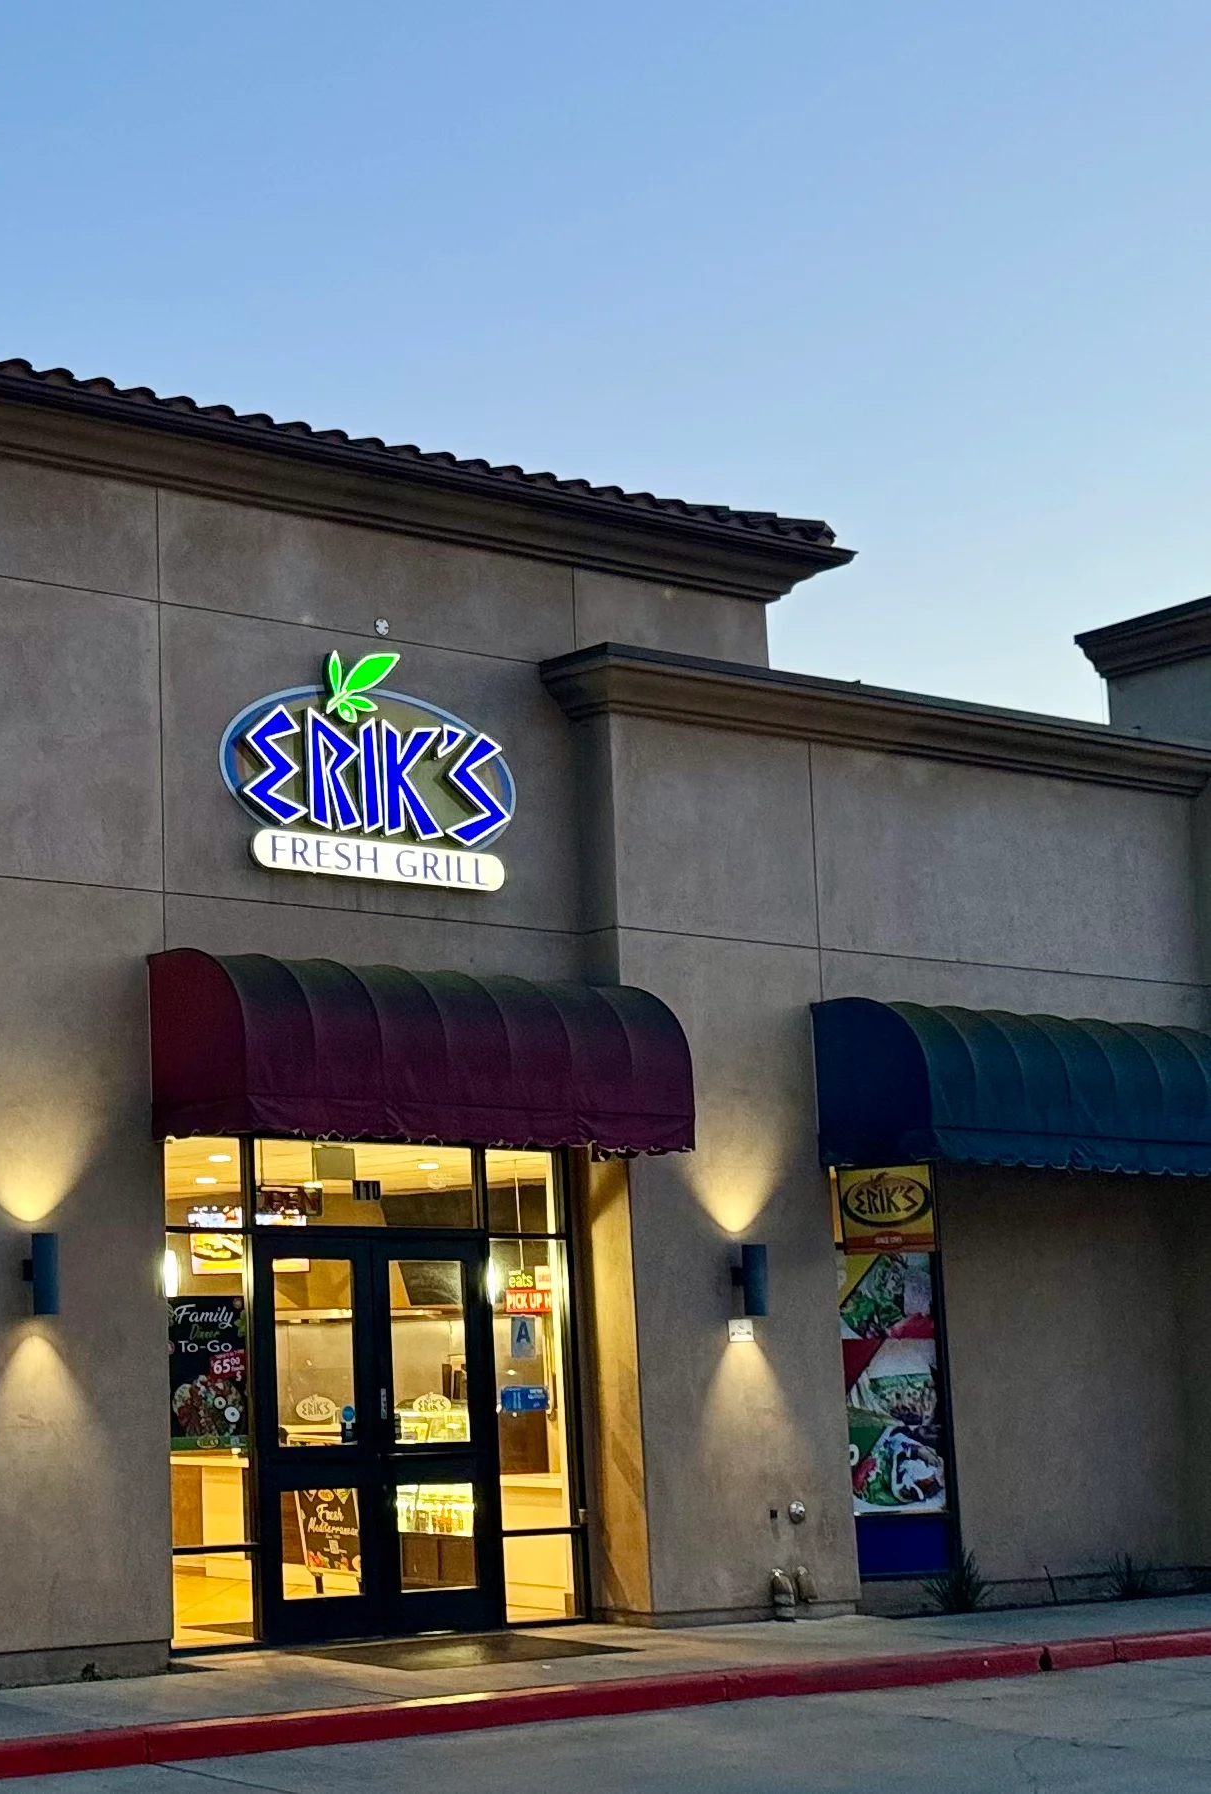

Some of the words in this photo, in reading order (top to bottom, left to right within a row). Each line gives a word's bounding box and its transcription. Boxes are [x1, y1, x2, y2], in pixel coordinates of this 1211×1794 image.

[242, 704, 511, 846] ERIK'S
[270, 835, 379, 874] FRESH
[395, 849, 489, 886] GRILL
[854, 1185, 918, 1214] ERIK'S
[509, 1273, 533, 1288] eats
[506, 1293, 527, 1311] PICK
[530, 1293, 542, 1310] UP
[174, 1303, 233, 1329] Family
[517, 1321, 531, 1344] A
[177, 1340, 232, 1353] To-Go
[302, 1401, 331, 1416] ERIK'S
[418, 1398, 446, 1412] ERIK'S
